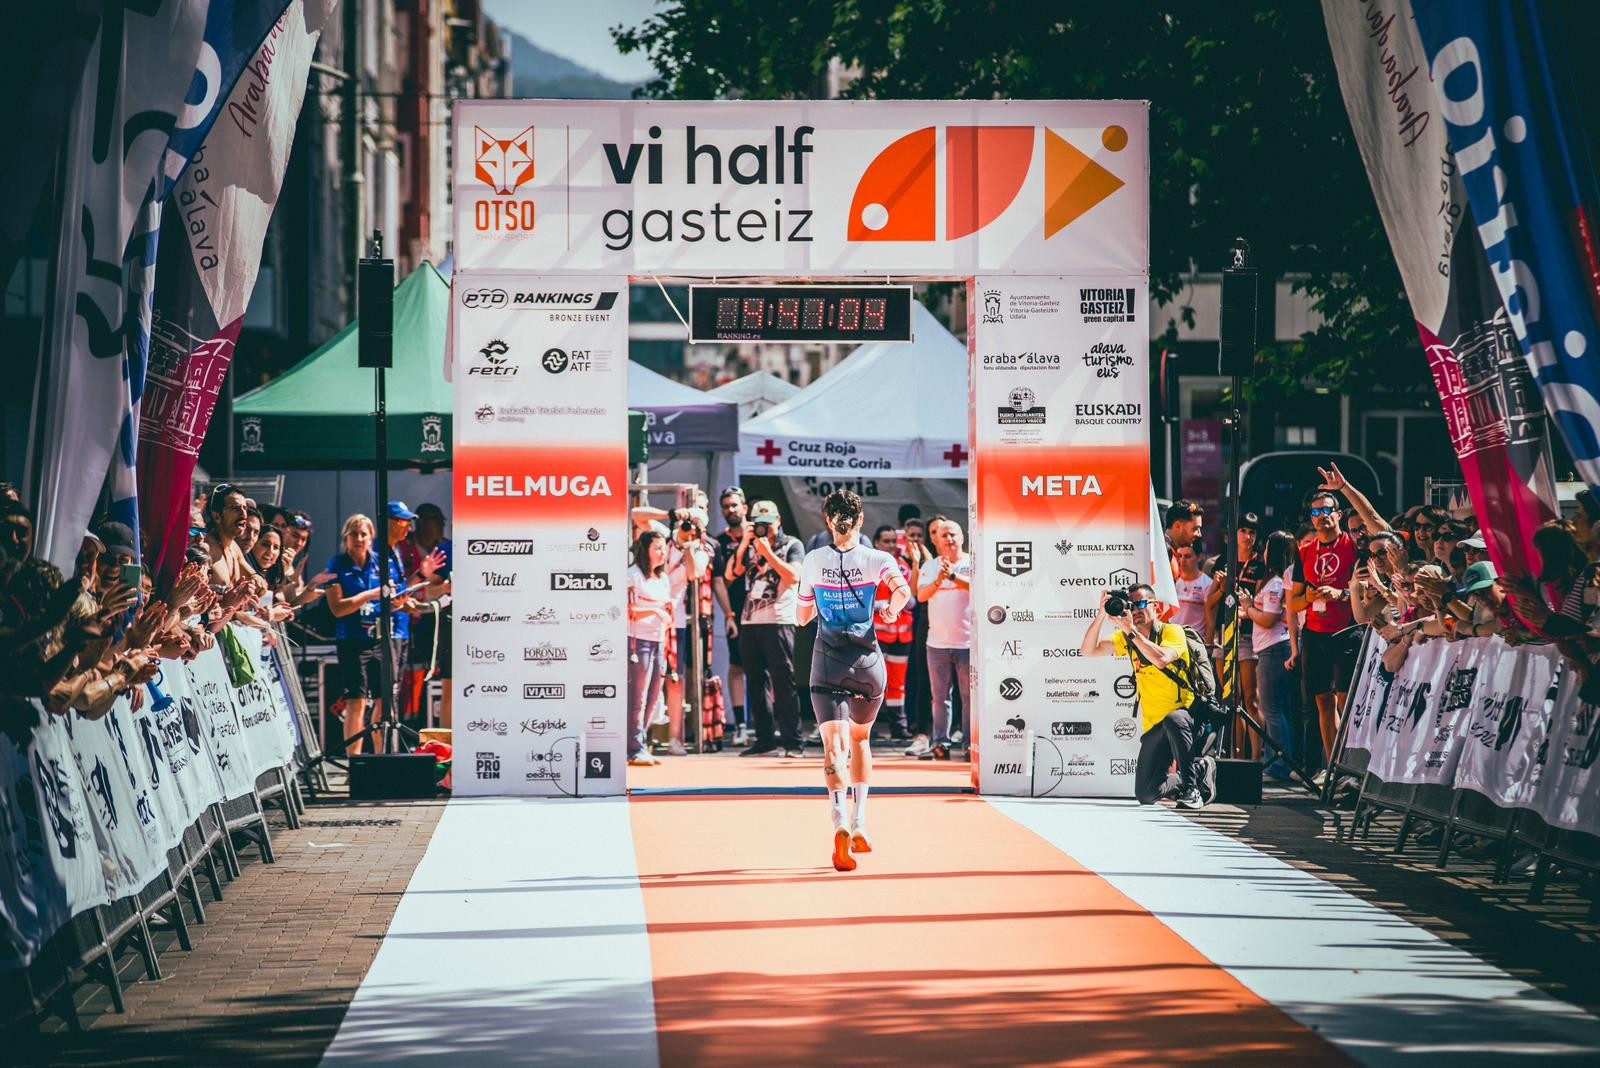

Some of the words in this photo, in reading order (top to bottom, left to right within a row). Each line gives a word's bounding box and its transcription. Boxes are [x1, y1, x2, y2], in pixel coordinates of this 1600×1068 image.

[602, 125, 663, 185] vi
[686, 125, 815, 186] half
[475, 200, 535, 231] OTSO
[602, 198, 814, 251] gasteiz
[513, 293, 593, 304] RANKINGS
[1080, 288, 1124, 301] VITORIA
[1080, 302, 1124, 315] GASTEIZ
[550, 314, 582, 322] BRONZE
[585, 314, 610, 322] EVENT
[1083, 315, 1101, 323] green
[1103, 314, 1125, 323] capital
[571, 350, 591, 360] FAT
[983, 353, 1017, 364] araba
[570, 362, 591, 372] ATF
[1096, 366, 1120, 378] eus
[1075, 403, 1142, 416] EUSKADI
[788, 440, 821, 452] Cruz
[825, 441, 856, 457] Roja
[788, 455, 845, 468] Gurutze
[848, 457, 892, 470] Gorria
[465, 475, 612, 496] HELMUGA
[1021, 475, 1103, 496] META
[486, 542, 532, 554] ENERVIT
[1077, 544, 1103, 552] RURAL
[481, 571, 517, 586] Vital
[1060, 576, 1106, 587] evento
[460, 615, 481, 623] PAIN
[523, 647, 568, 658] FORONDA
[480, 685, 508, 693] CANO
[527, 687, 561, 697] VIALKI
[993, 763, 1022, 775] INSAL
